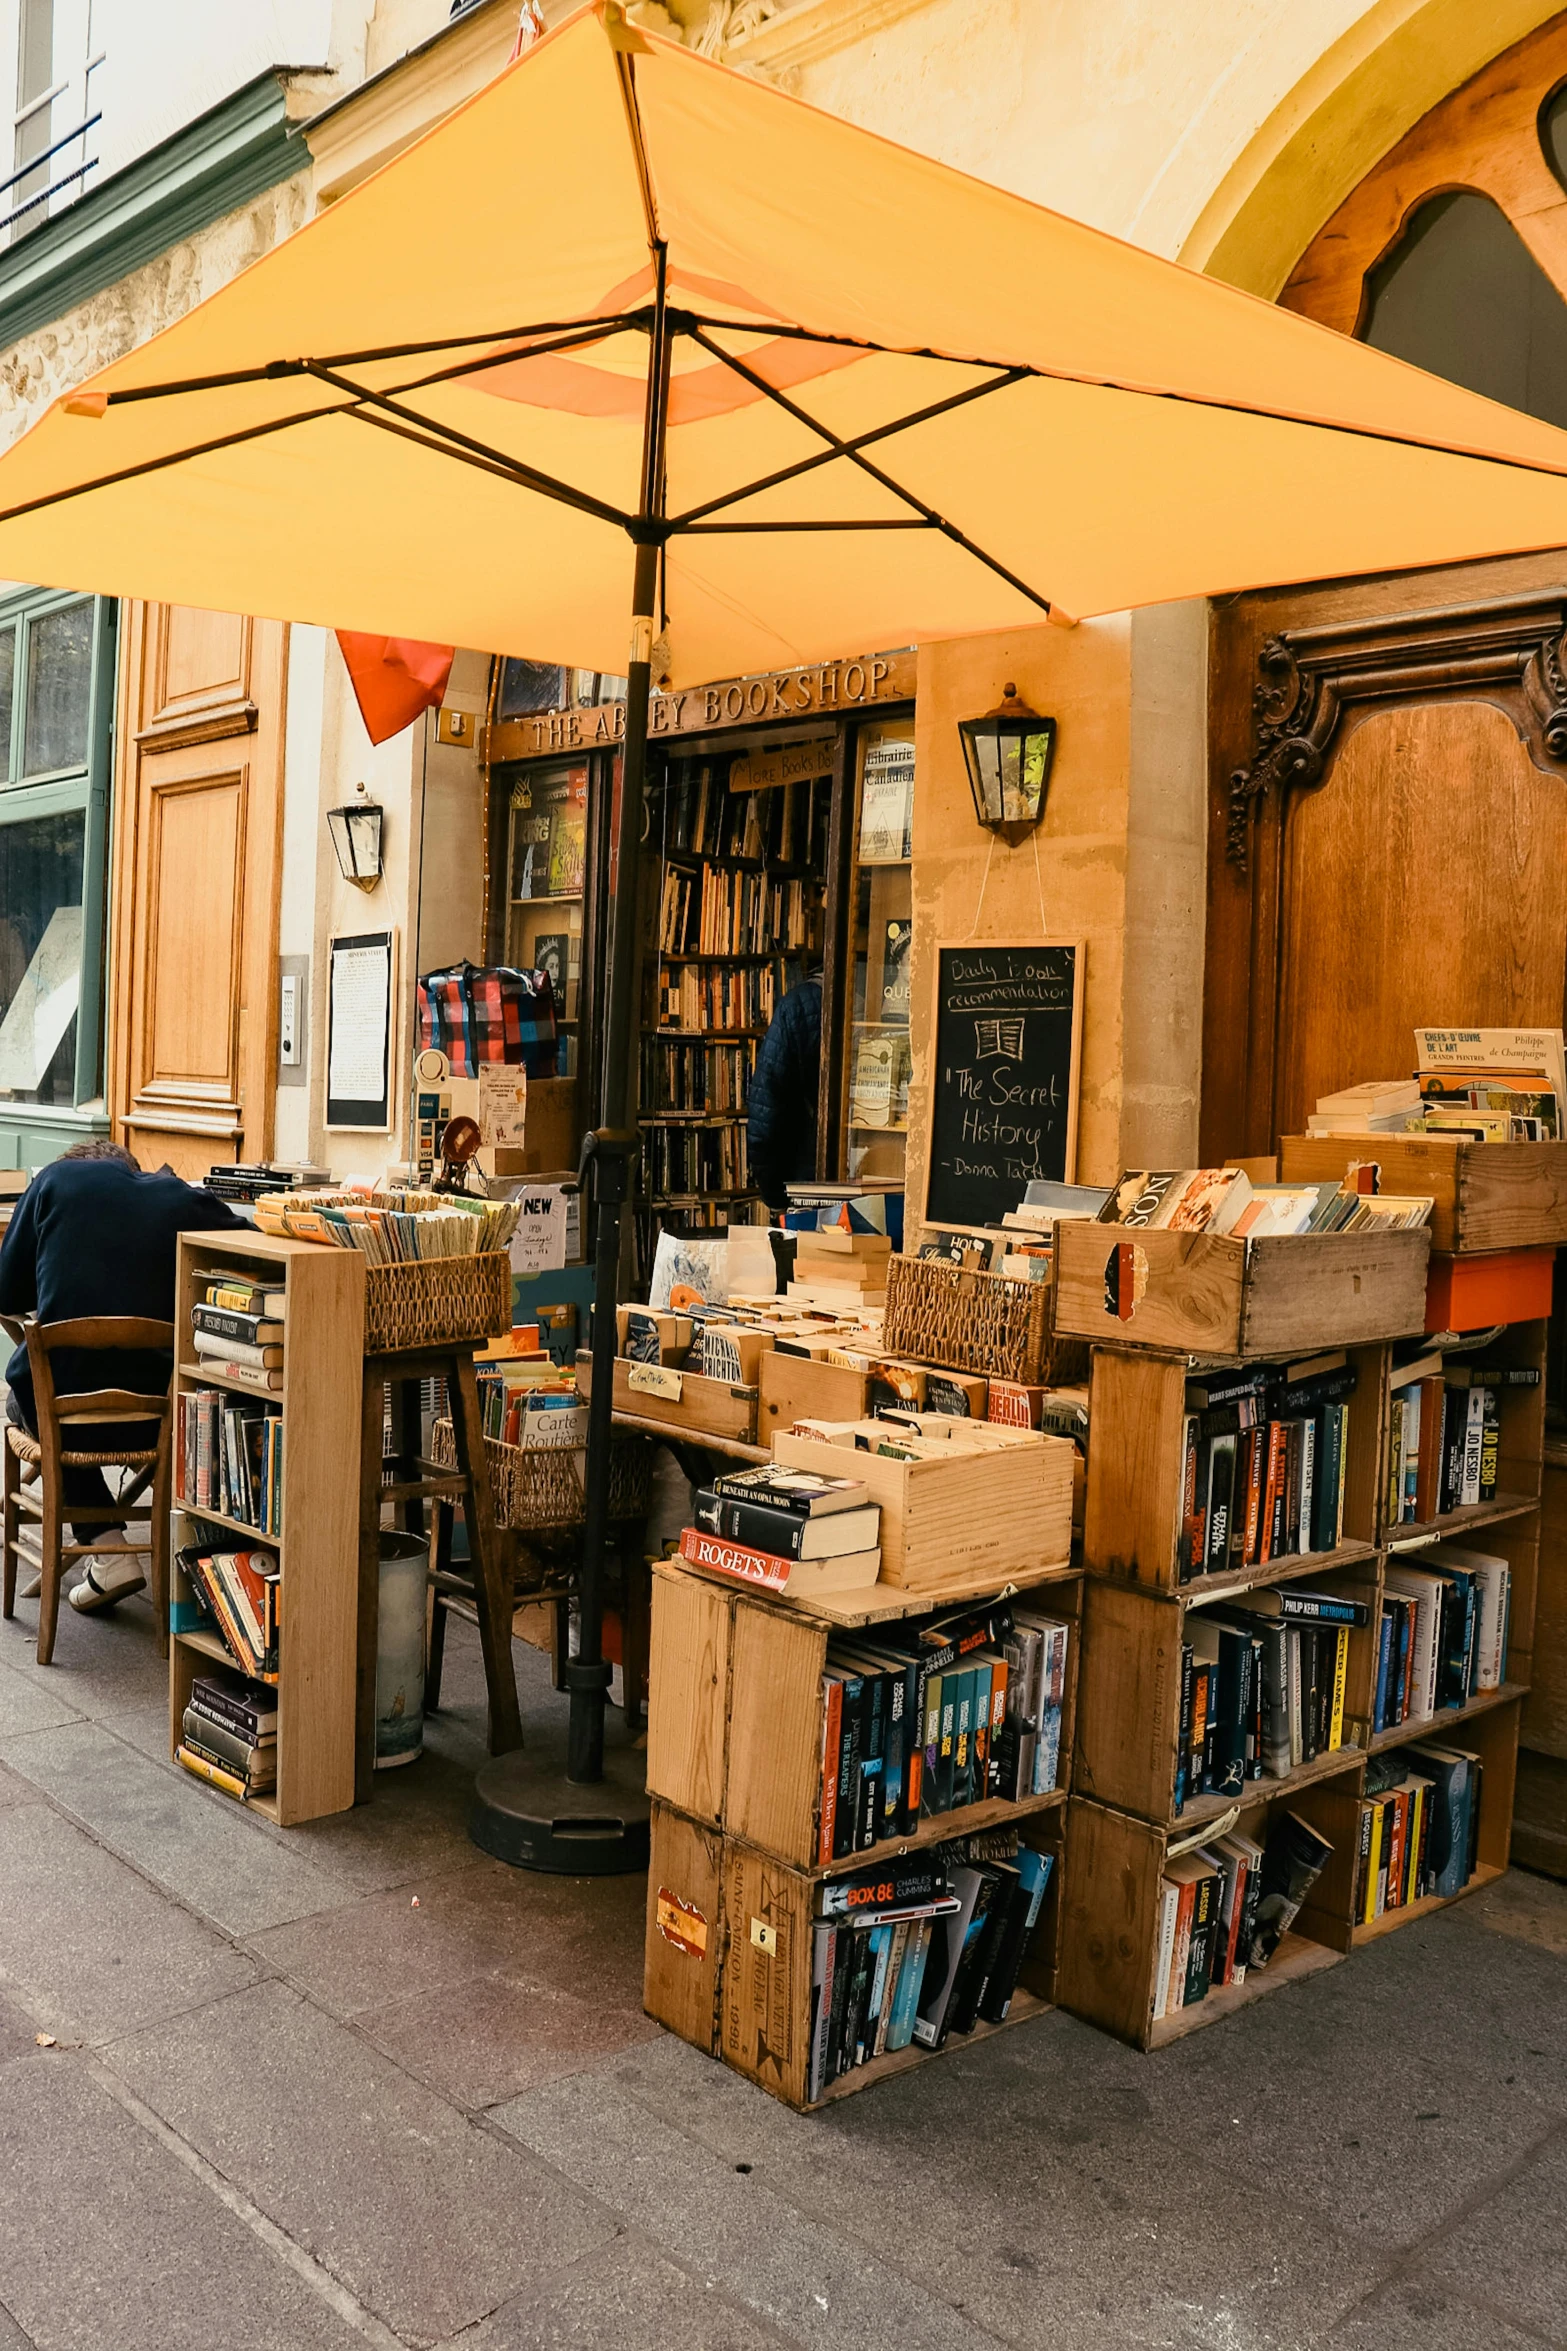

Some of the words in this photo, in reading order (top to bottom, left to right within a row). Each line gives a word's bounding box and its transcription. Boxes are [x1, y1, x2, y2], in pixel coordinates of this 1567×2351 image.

[532, 714, 583, 752] THE
[595, 695, 688, 742] ABEY
[703, 659, 891, 724] BOOKSHOP
[782, 755, 813, 779] Books
[867, 748, 912, 765] Librairie
[523, 825, 549, 844] KING
[951, 957, 997, 981] Daily
[947, 985, 1070, 1009] recommendation
[1427, 1043, 1436, 1052] DE
[1439, 1043, 1458, 1052] L'ART
[1489, 1047, 1499, 1056] de
[1501, 1047, 1547, 1061] Champaigne
[1514, 1035, 1545, 1049] Philippe
[1428, 1053, 1454, 1061] GRANDS
[1456, 1054, 1485, 1062] PEINTRES
[988, 1065, 1062, 1107] Secret
[954, 1156, 999, 1180] Donna
[1003, 1156, 1047, 1180] Tartt
[523, 1198, 552, 1216] NEW
[704, 1333, 739, 1362] MICHAEL
[703, 1355, 742, 1384] CRICHTON
[895, 1398, 917, 1413] TAMI
[988, 1392, 1029, 1423] BERLIN
[537, 1413, 578, 1432] Carte
[1484, 1428, 1499, 1445] JO
[525, 1432, 585, 1449] Routière
[1467, 1430, 1480, 1445] JO
[1252, 1448, 1261, 1488] INVOLVED
[1275, 1453, 1287, 1496] SYSTEM
[1305, 1432, 1315, 1490] GERRITSEN
[1465, 1447, 1479, 1482] NESBO
[1481, 1448, 1497, 1486] NESBO
[1184, 1446, 1196, 1517] SILKWORM
[721, 1484, 750, 1500] BENEATH
[749, 1491, 758, 1502] AN
[757, 1492, 772, 1505] OPAL
[772, 1496, 791, 1508] MOON
[1211, 1512, 1221, 1556] WHITE
[1219, 1505, 1227, 1546] LETHAL
[698, 1540, 767, 1580] ROGET'S
[1285, 1600, 1303, 1614] PHILIP
[1304, 1602, 1319, 1616] KERR
[1320, 1604, 1355, 1621] METROPOLIS
[925, 1651, 955, 1674] ONNELLY
[1185, 1651, 1193, 1669] THE
[1337, 1630, 1346, 1672] PETER
[916, 1670, 926, 1713] Michael
[1184, 1670, 1192, 1697] STREET
[1334, 1673, 1343, 1717] JAMES
[871, 1681, 882, 1717] MICHAEL
[1194, 1676, 1208, 1747] SCRUBLANDS
[1182, 1698, 1190, 1729] LAWYER
[843, 1733, 851, 1752] THE
[851, 1718, 861, 1748] JOHN
[869, 1718, 881, 1757] CONNELLY
[914, 1712, 924, 1748] Connelly
[826, 1776, 835, 1798] We'll
[840, 1753, 850, 1796] REAPERS
[868, 1781, 876, 1796] CITY
[824, 1799, 834, 1821] Meet
[867, 1797, 874, 1806] OF
[823, 1820, 833, 1849] Again
[1361, 1812, 1371, 1855] BEQUEST
[847, 1884, 876, 1907] BOX
[876, 1882, 895, 1902] 88
[896, 1875, 931, 1889] CHARLES
[896, 1884, 931, 1898] CUMMING
[1167, 1897, 1175, 1923] PHILIP
[1198, 1880, 1210, 1923] LARSSON
[759, 1928, 766, 1943] 6
[914, 1940, 922, 1953] FOR
[826, 1932, 836, 1970] SPEAKING
[912, 1954, 920, 1968] DAY
[822, 1980, 831, 2016] TONGUES
[907, 1971, 916, 2000] PATRICK
[729, 2002, 740, 2051] 1998
[820, 2017, 829, 2049] JEFFERY
[817, 2049, 826, 2081] DEAVER
